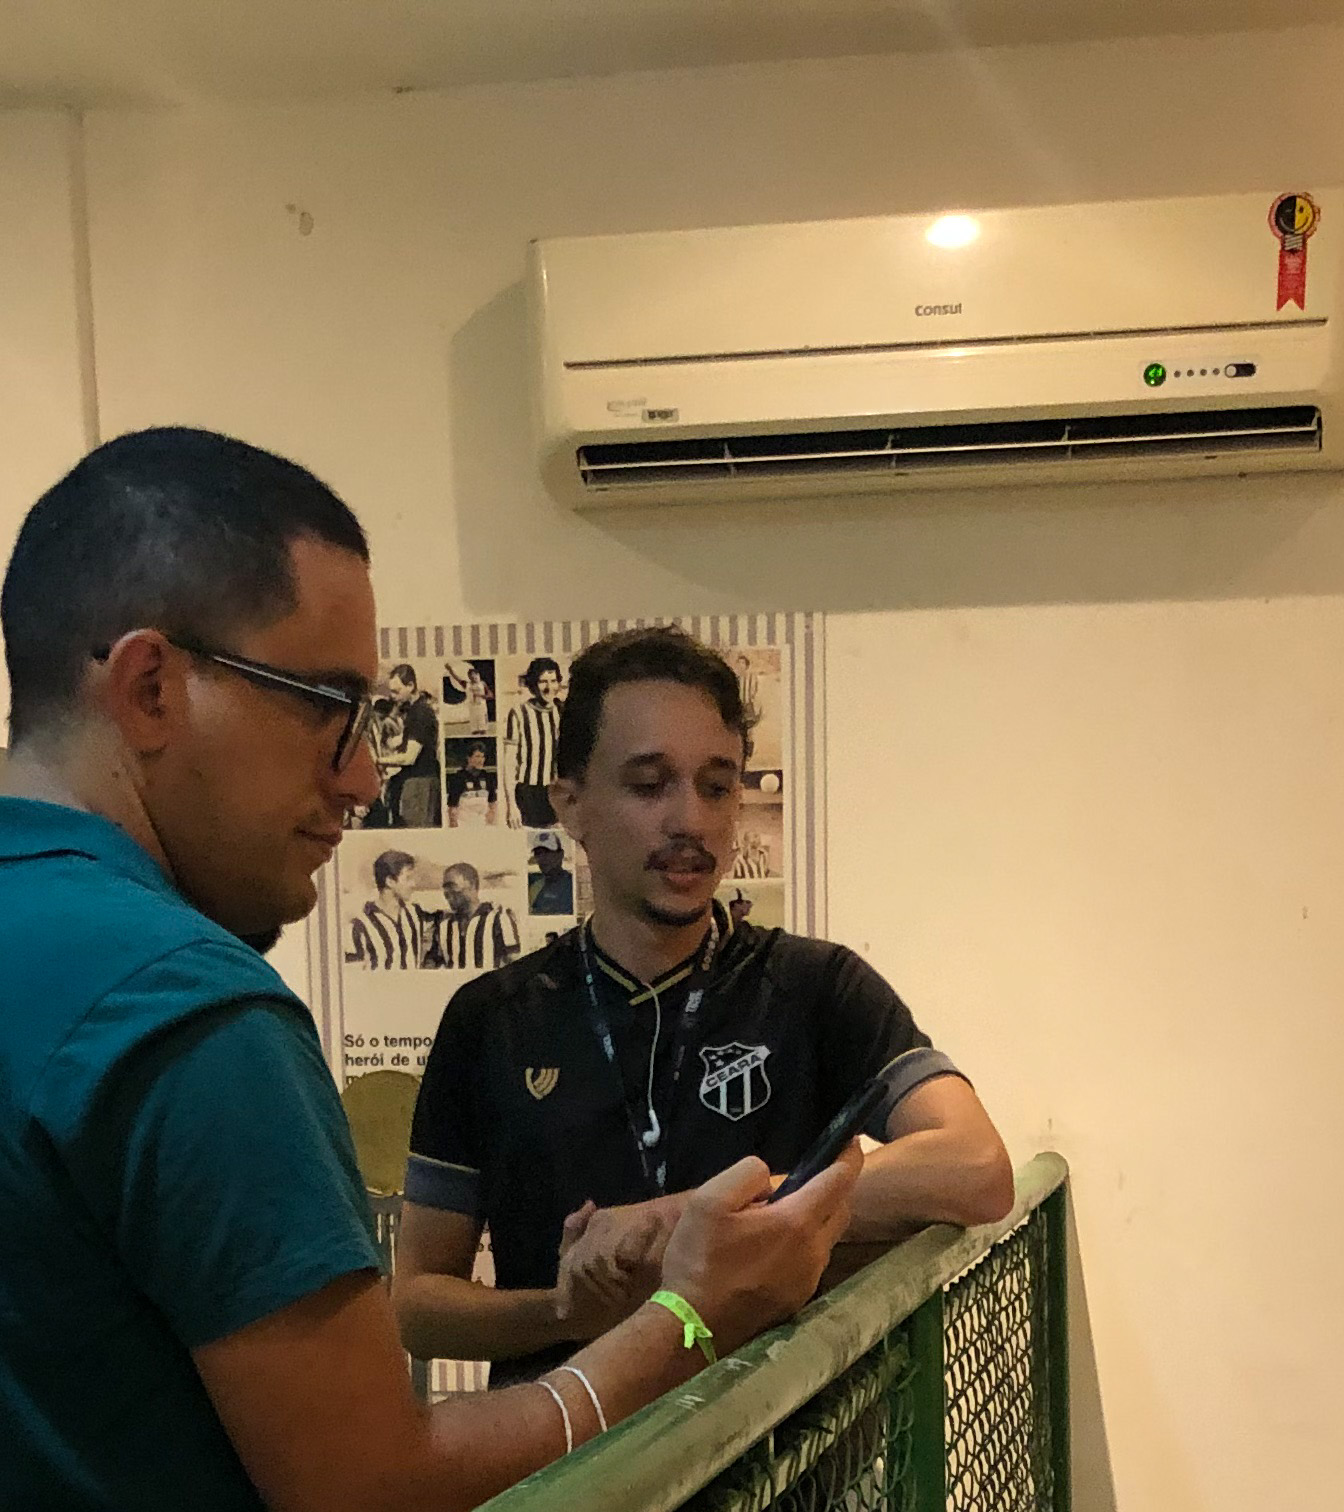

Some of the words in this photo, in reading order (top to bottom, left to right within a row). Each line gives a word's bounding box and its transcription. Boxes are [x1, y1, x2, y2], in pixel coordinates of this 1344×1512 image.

[344, 1034, 365, 1048] Só
[369, 1037, 380, 1047] o
[384, 1035, 433, 1050] tempo
[345, 1053, 384, 1067] herói
[391, 1053, 410, 1066] de
